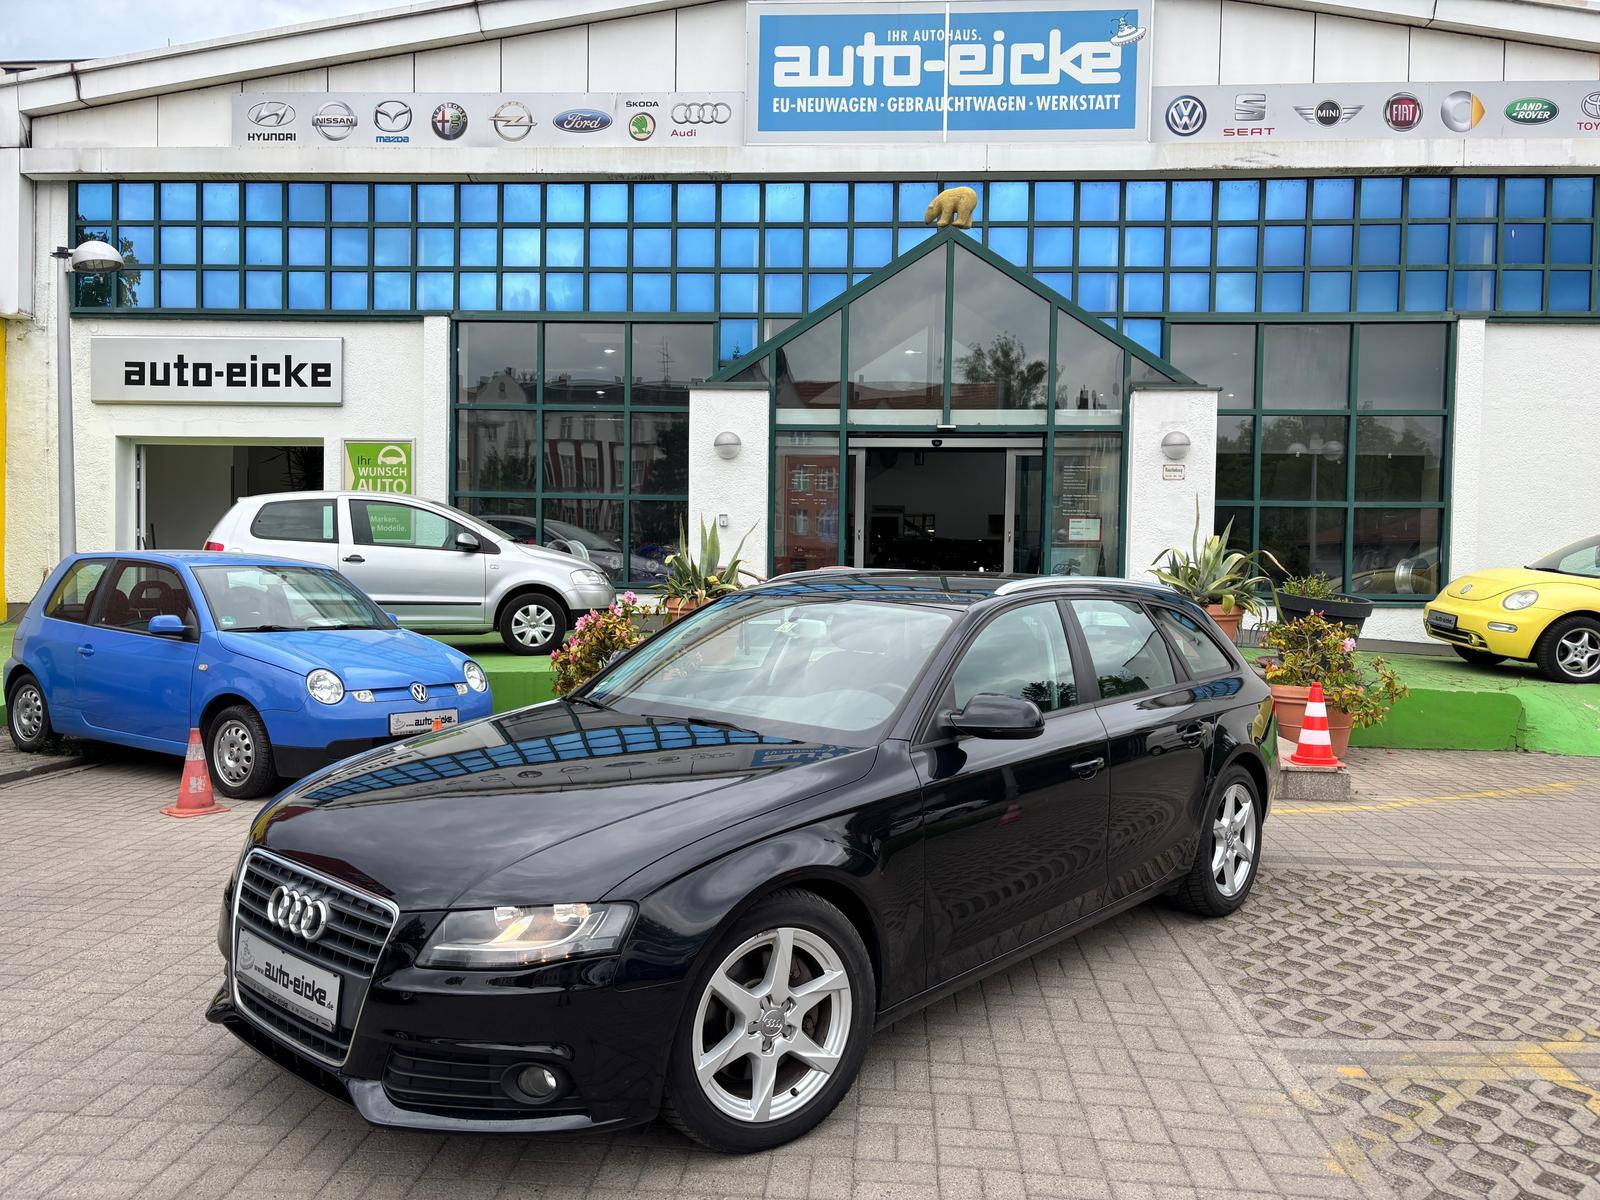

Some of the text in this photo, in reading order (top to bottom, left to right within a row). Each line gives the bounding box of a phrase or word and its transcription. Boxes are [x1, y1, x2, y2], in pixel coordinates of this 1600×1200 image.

[887, 29, 982, 42] IHR AUTOHAUS.
[774, 29, 1121, 87] auto-eicke
[625, 100, 660, 108] ŠKODA
[773, 94, 1121, 113] EU-NEUWAGEN GEBRAUCHTWAGEN WERKSTATT
[1317, 109, 1340, 118] MINI
[1392, 104, 1415, 122] FIAT
[1517, 111, 1551, 119] ROVER
[316, 117, 354, 125] NISSAN
[563, 112, 600, 129] Ford
[247, 132, 297, 142] HYUNDAI
[670, 128, 697, 137] Audi
[1223, 127, 1275, 137] SEAT
[124, 354, 332, 388] auto-eicke
[357, 456, 371, 465] Ihr
[358, 467, 407, 477] WUNSCH
[358, 479, 407, 494] AUTO
[377, 525, 407, 533] Modelle.
